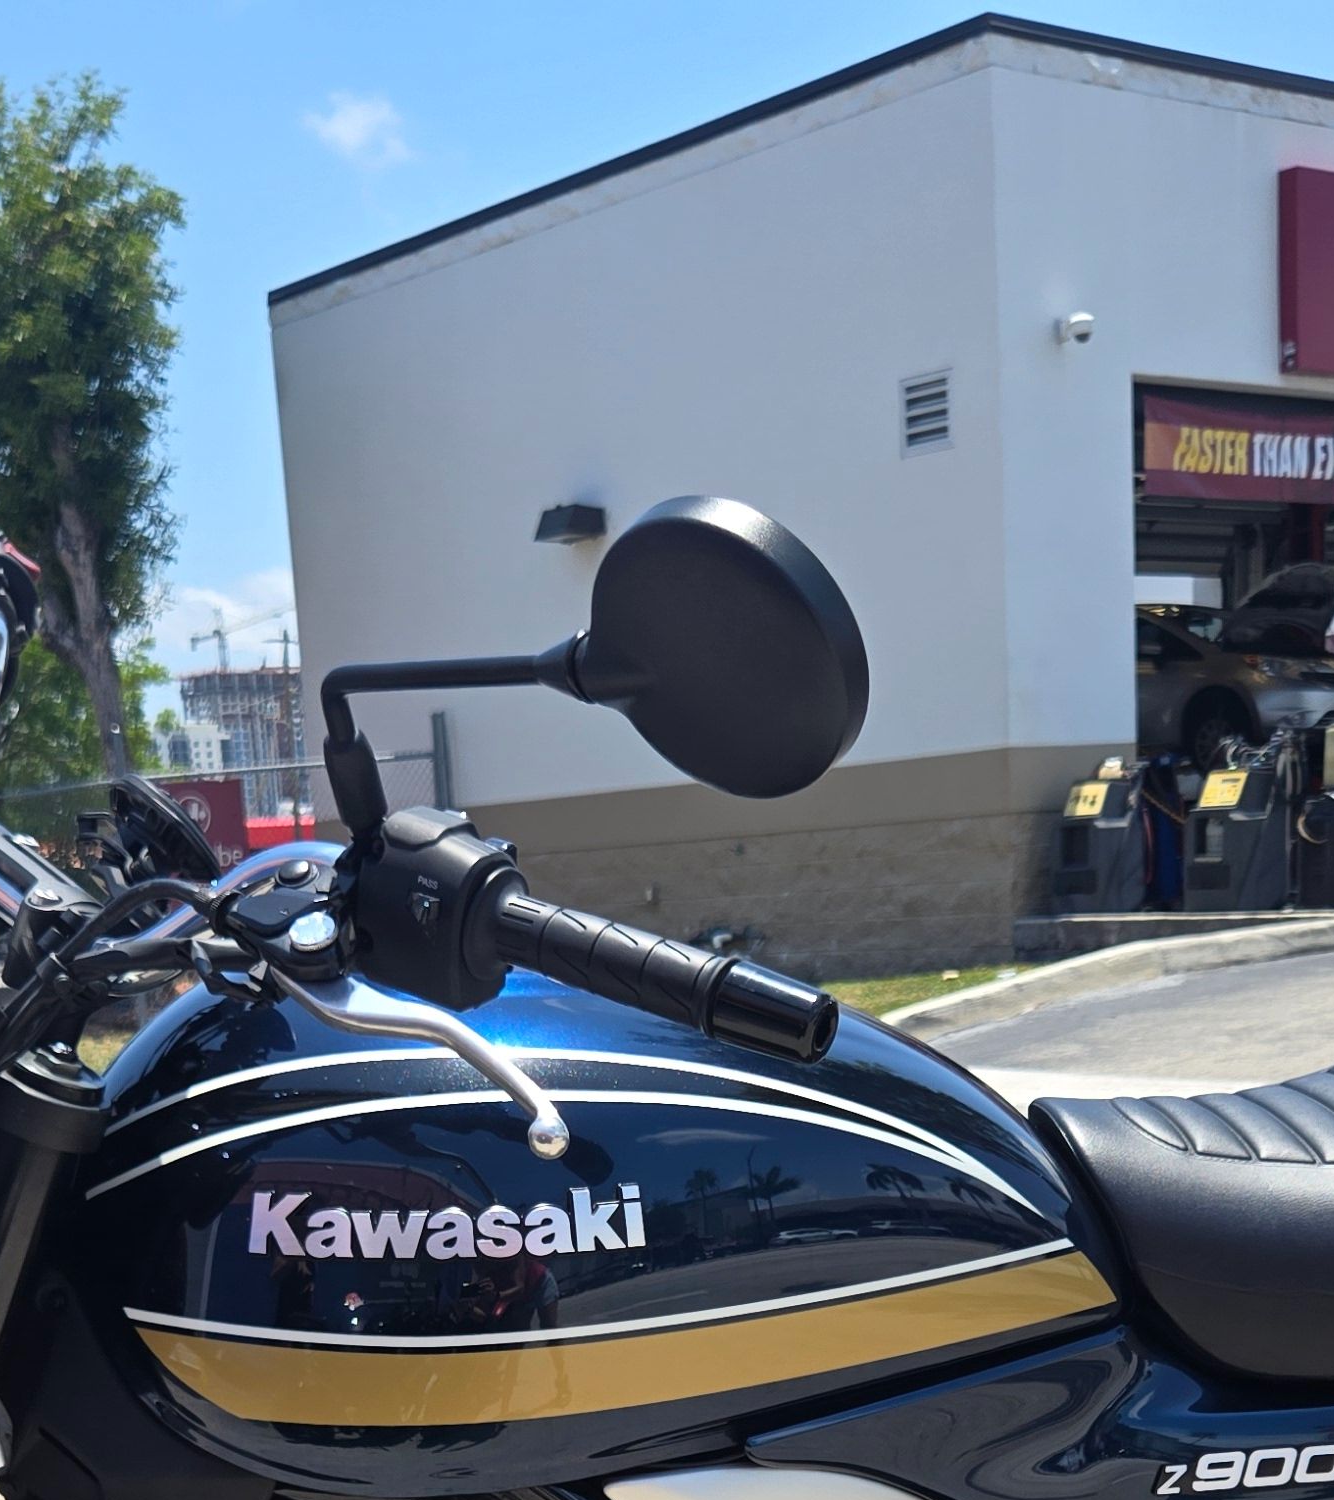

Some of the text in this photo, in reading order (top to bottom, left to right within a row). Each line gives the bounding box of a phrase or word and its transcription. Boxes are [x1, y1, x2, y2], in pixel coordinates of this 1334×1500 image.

[1173, 427, 1249, 476] FASTER
[1253, 433, 1310, 479] THAN
[417, 875, 438, 890] PASS
[248, 1182, 646, 1260] Kawasaki
